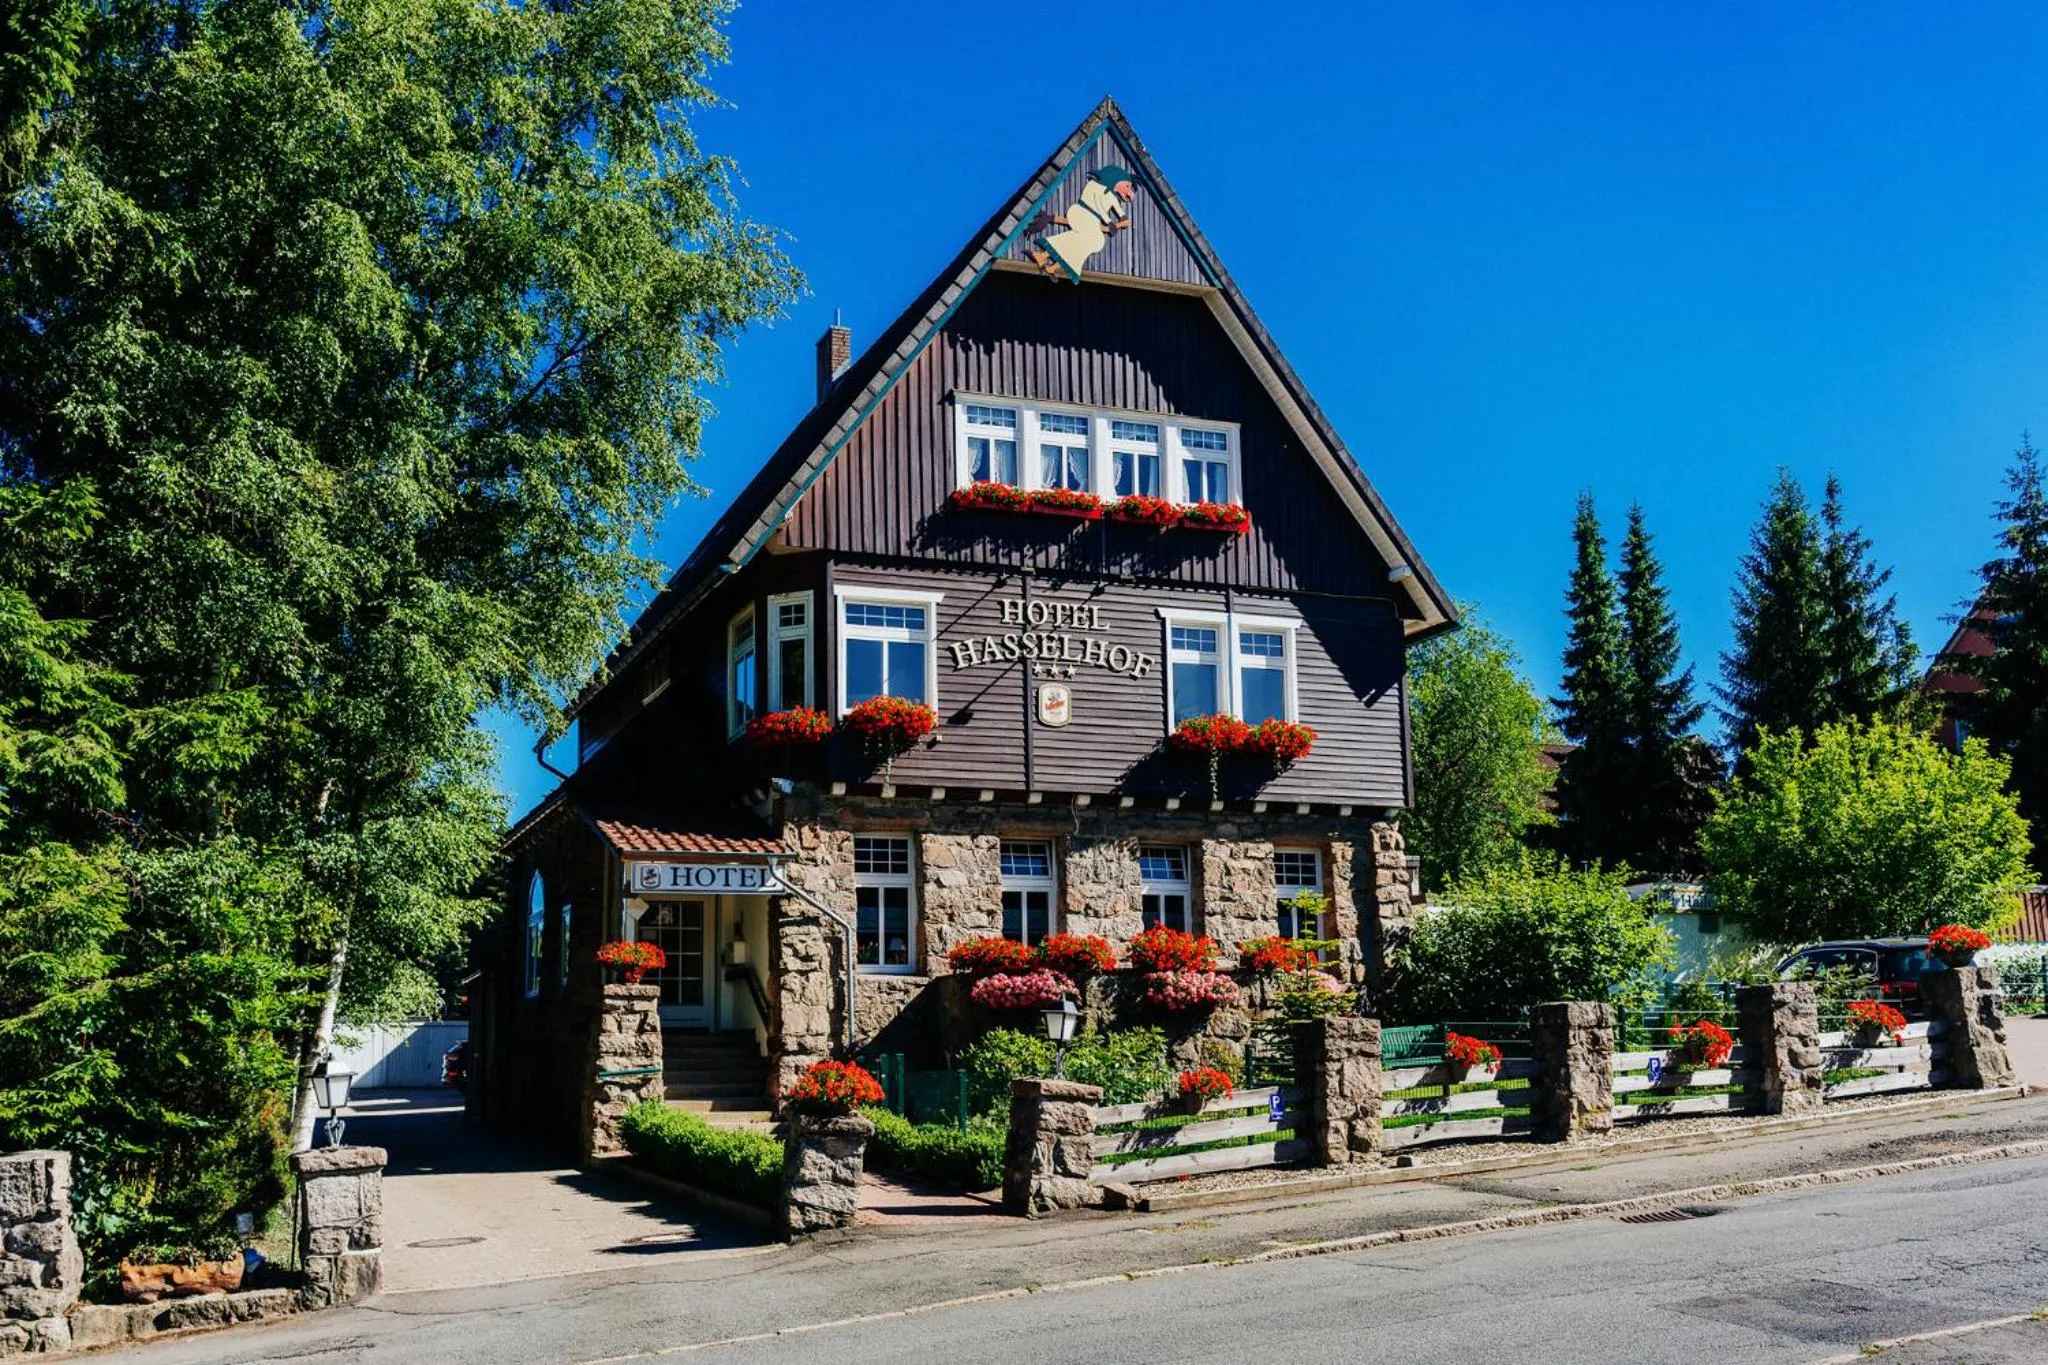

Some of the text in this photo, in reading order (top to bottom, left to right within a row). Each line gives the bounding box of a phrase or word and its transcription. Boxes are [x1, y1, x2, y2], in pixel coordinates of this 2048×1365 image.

[1001, 598, 1110, 630] HOTEL
[950, 632, 1156, 678] HASSELHOF
[670, 867, 777, 888] HOTEL
[1272, 1095, 1280, 1109] P
